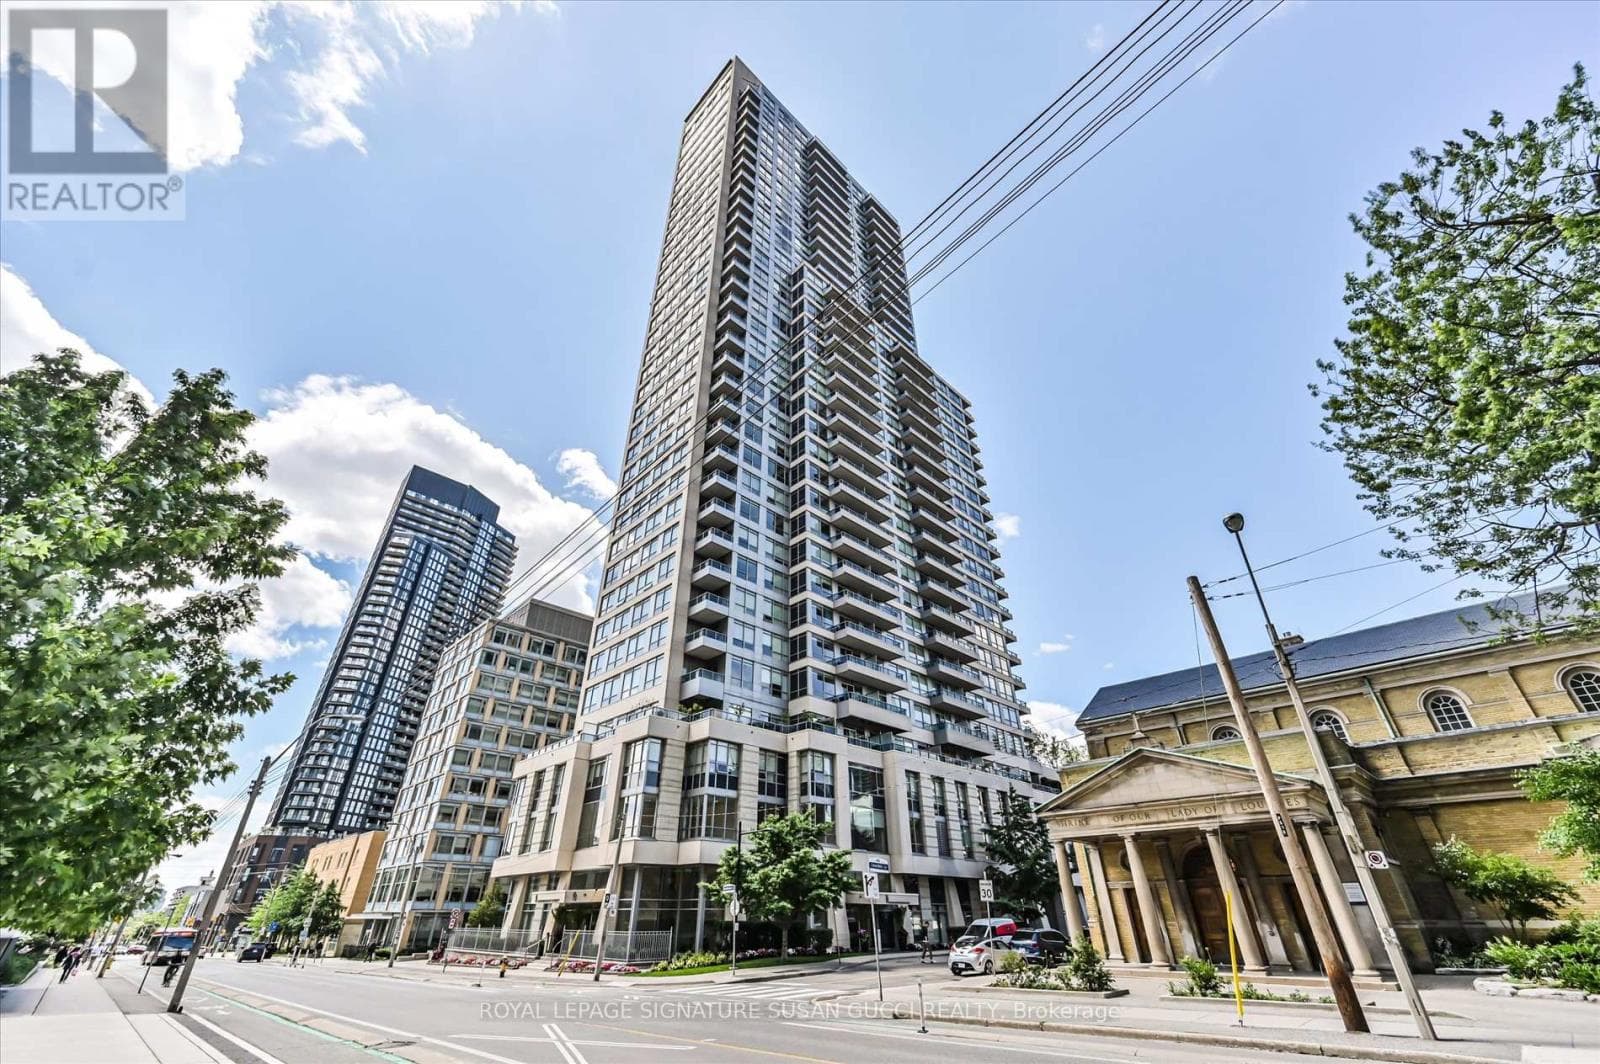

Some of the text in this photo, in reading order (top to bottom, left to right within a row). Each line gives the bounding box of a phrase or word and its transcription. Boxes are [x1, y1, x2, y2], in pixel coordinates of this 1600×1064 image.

[1171, 808, 1198, 817] LADY
[1241, 796, 1301, 811] LOUES
[981, 888, 992, 898] 30
